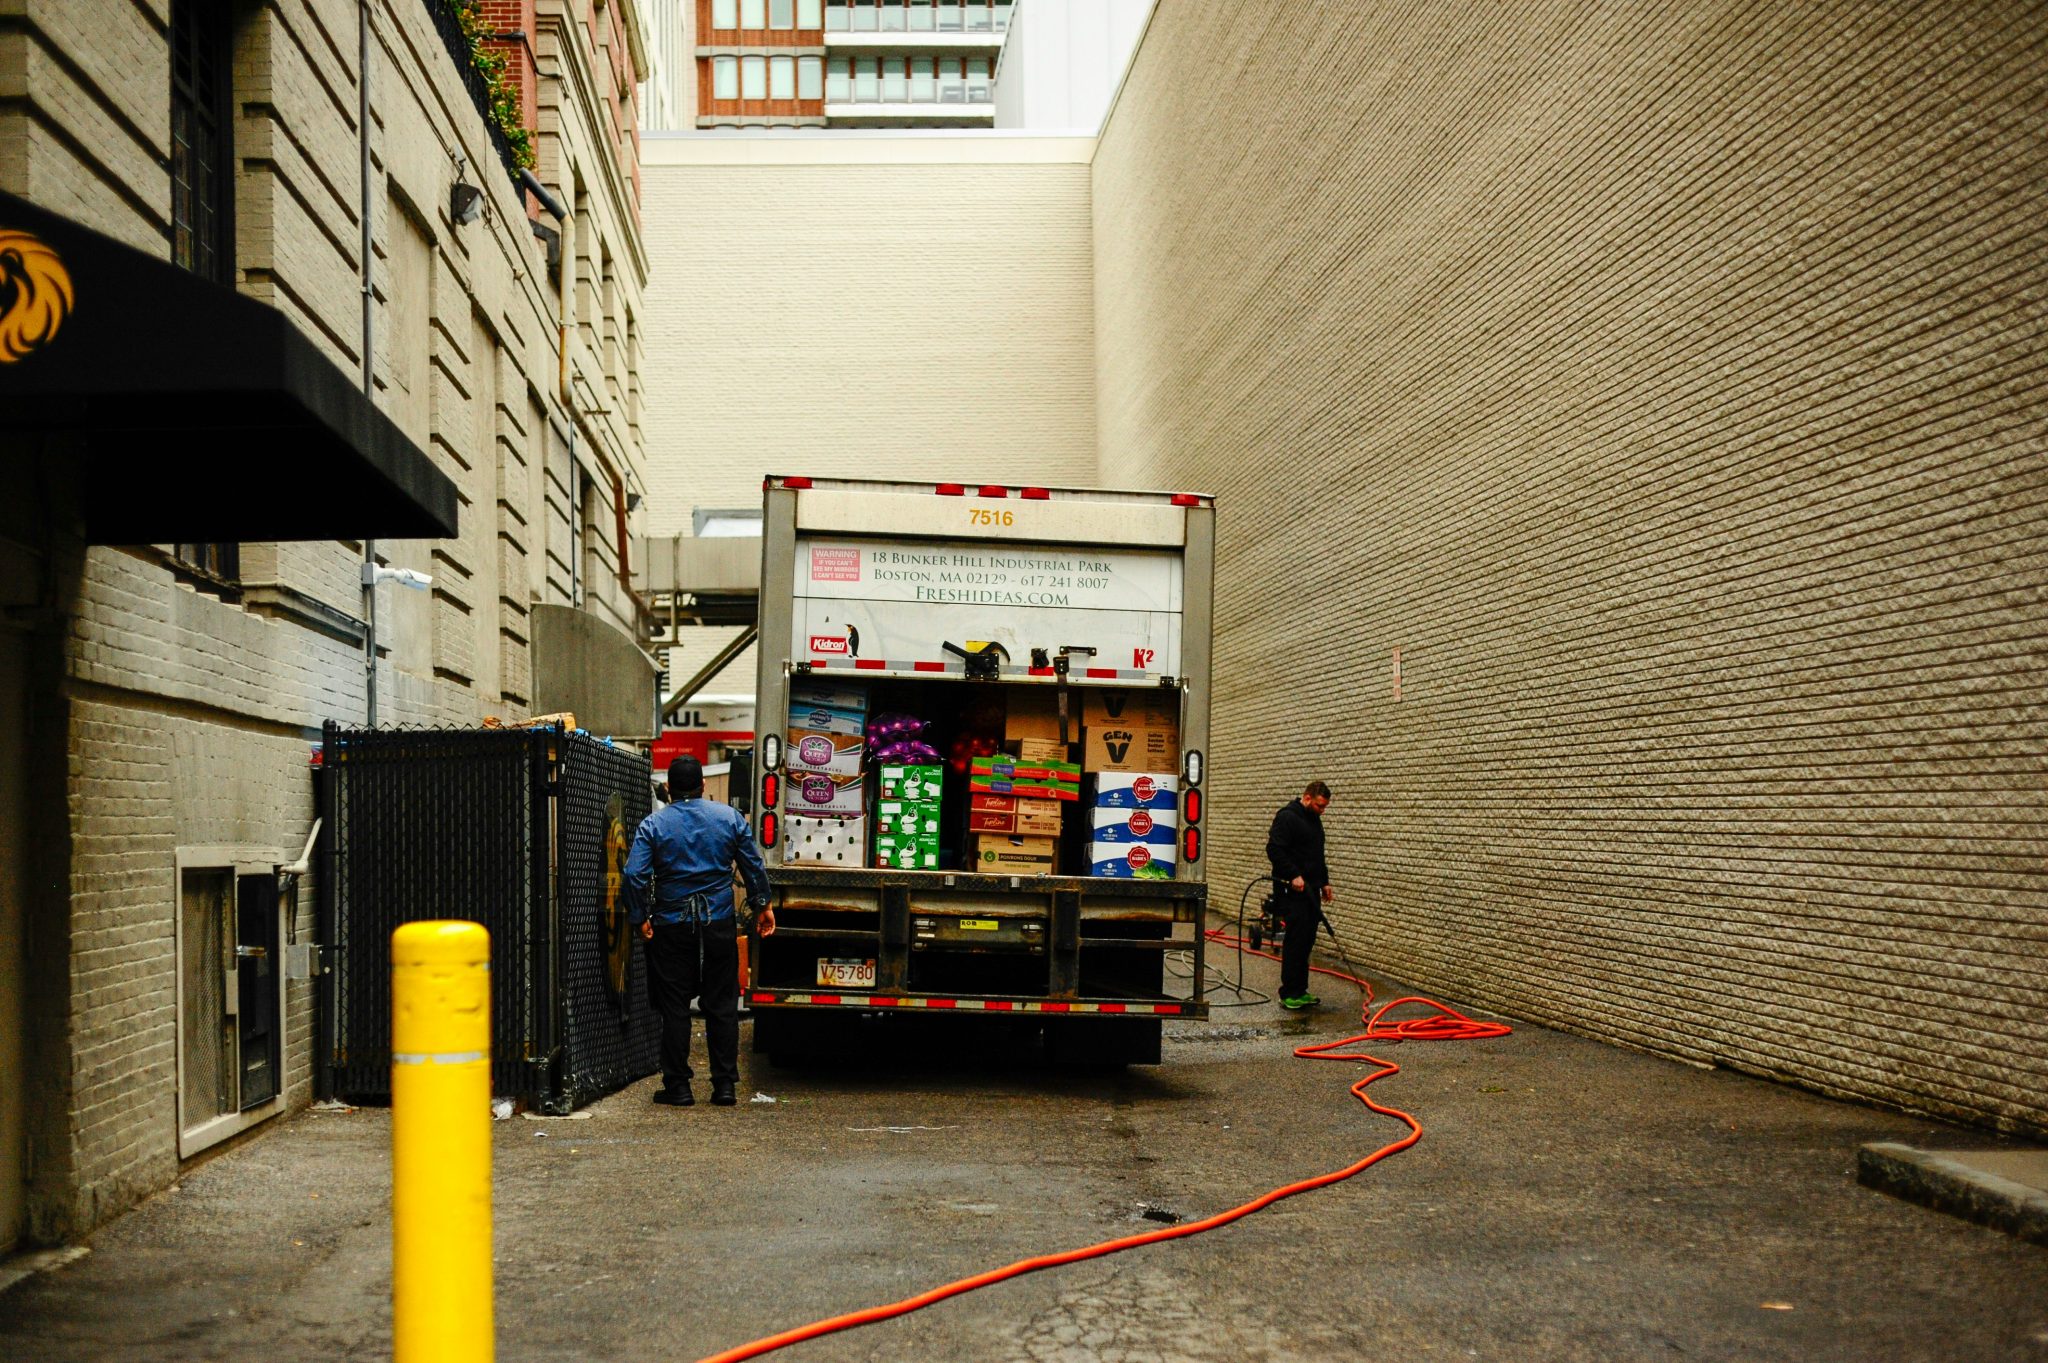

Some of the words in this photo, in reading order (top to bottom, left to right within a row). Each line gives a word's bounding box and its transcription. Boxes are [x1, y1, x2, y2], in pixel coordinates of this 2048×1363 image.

[969, 509, 1014, 527] 7516
[815, 550, 857, 559] WARNING
[872, 551, 887, 563] 18
[892, 552, 948, 566] BUNKER
[953, 555, 985, 568] HILL
[990, 556, 1074, 571] INDUSTRIAL
[1078, 560, 1113, 573] PARK
[940, 572, 963, 583] MA
[966, 572, 1007, 585] 02129
[1020, 575, 1045, 587] 617
[1049, 575, 1071, 588] 241
[1076, 577, 1109, 589] 8007
[916, 585, 1069, 606] FRESHIDEAS.COM
[813, 638, 846, 651] Kidron
[1103, 730, 1133, 742] GEN
[804, 750, 827, 759] QUEEN
[1105, 741, 1130, 764] V
[806, 789, 829, 797] QUEEN
